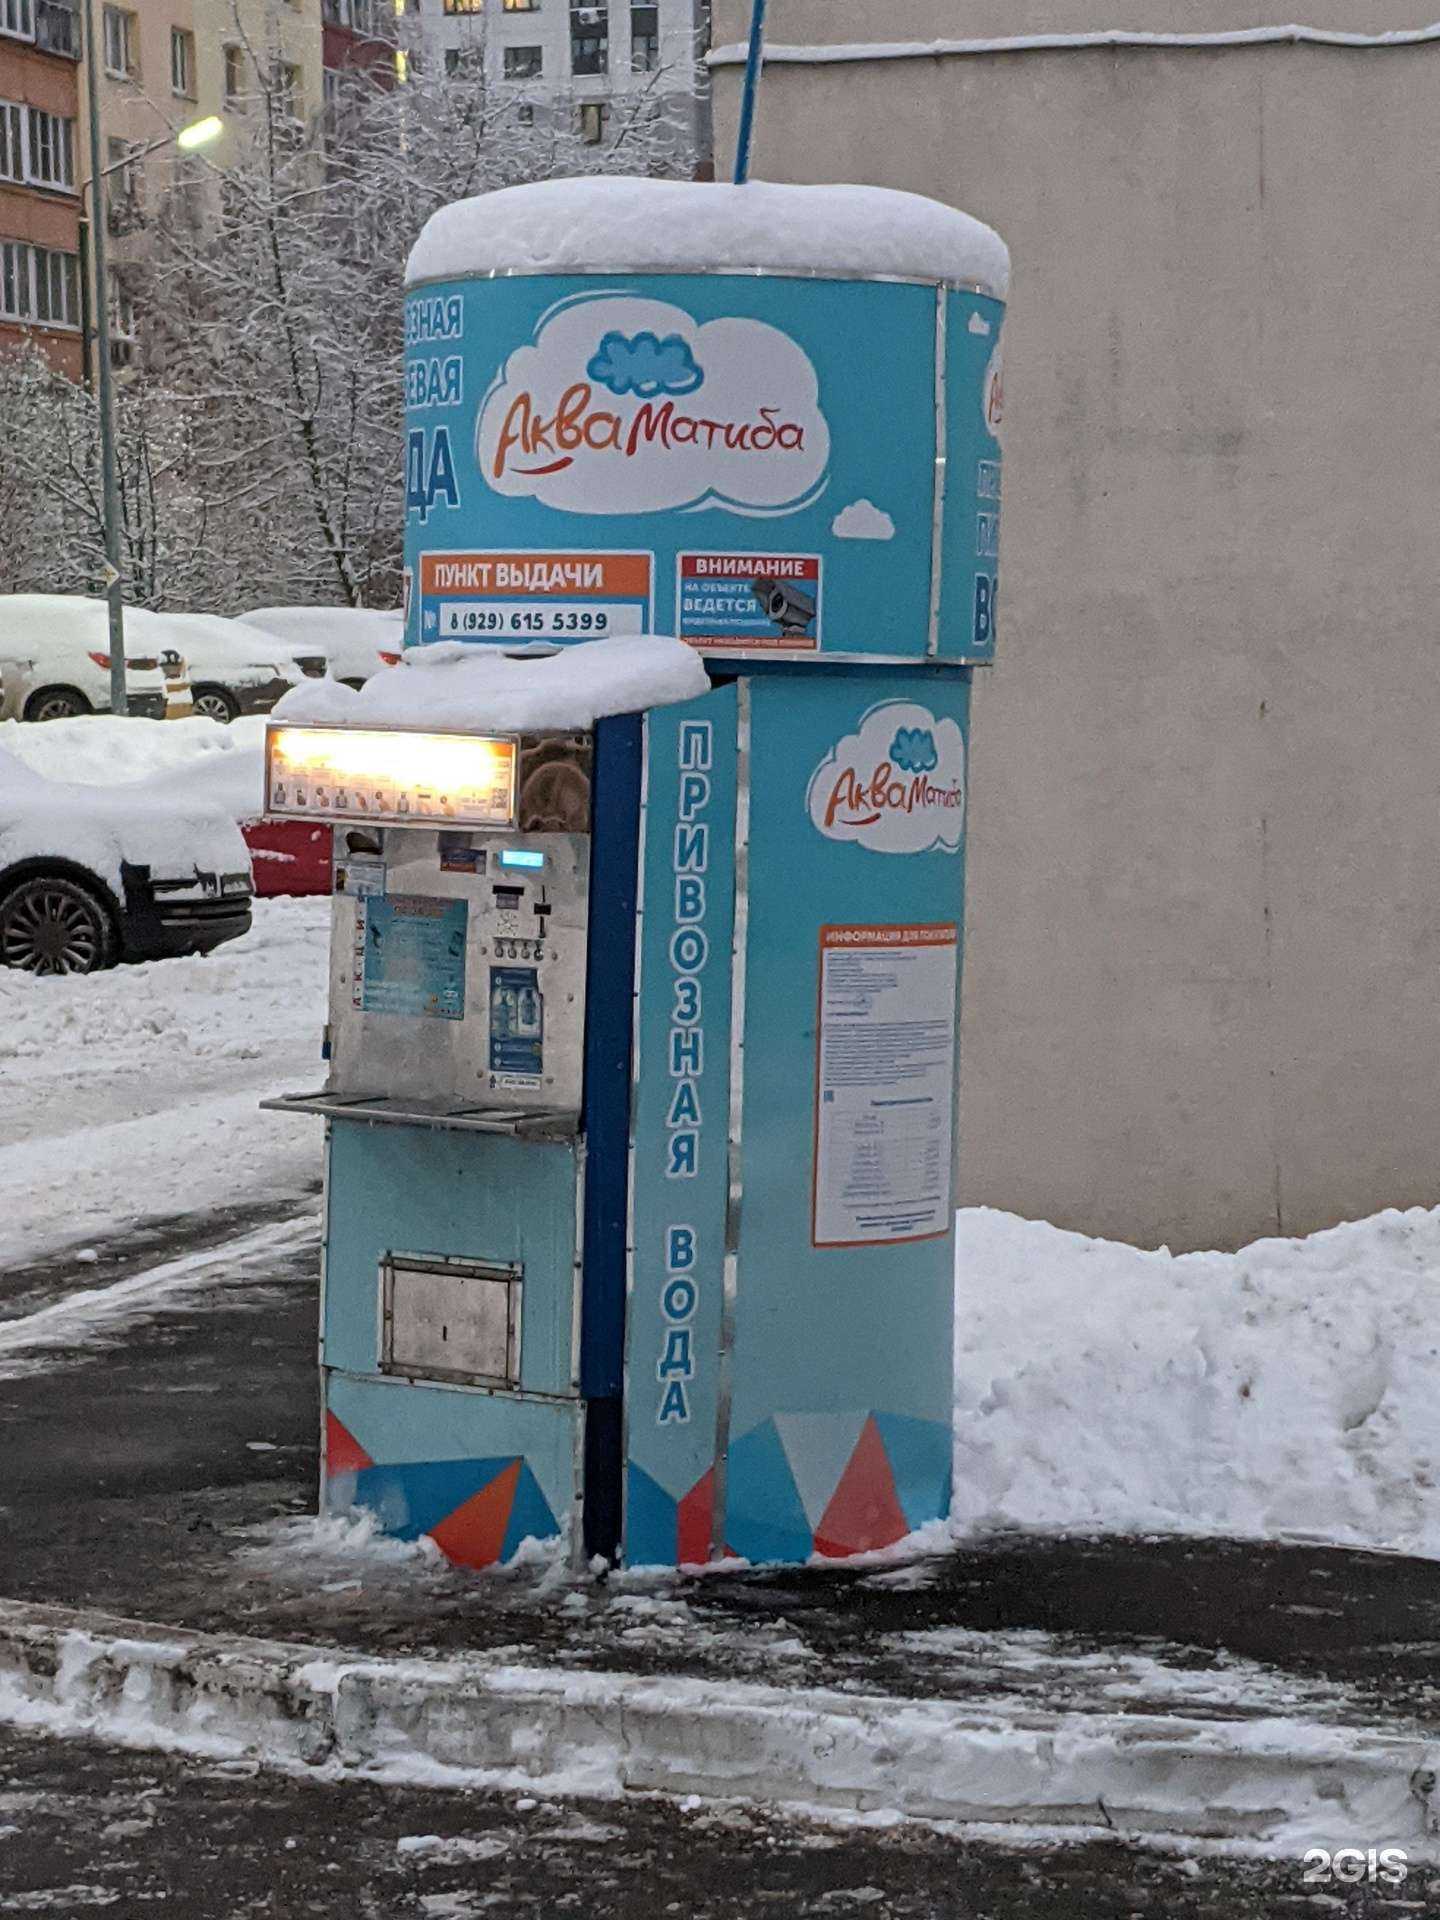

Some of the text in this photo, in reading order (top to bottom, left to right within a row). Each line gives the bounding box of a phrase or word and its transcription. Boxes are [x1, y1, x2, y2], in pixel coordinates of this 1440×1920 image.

[434, 563, 605, 592] ПУНКТ ВЫДАЧИ
[695, 558, 805, 576] ВНИМАНИЕ
[463, 612, 504, 631] (929)
[510, 613, 543, 631] 615
[552, 612, 608, 631] 5399
[666, 720, 712, 1178] ПРИВОЗНАЯ
[657, 1224, 699, 1425] ВОДА
